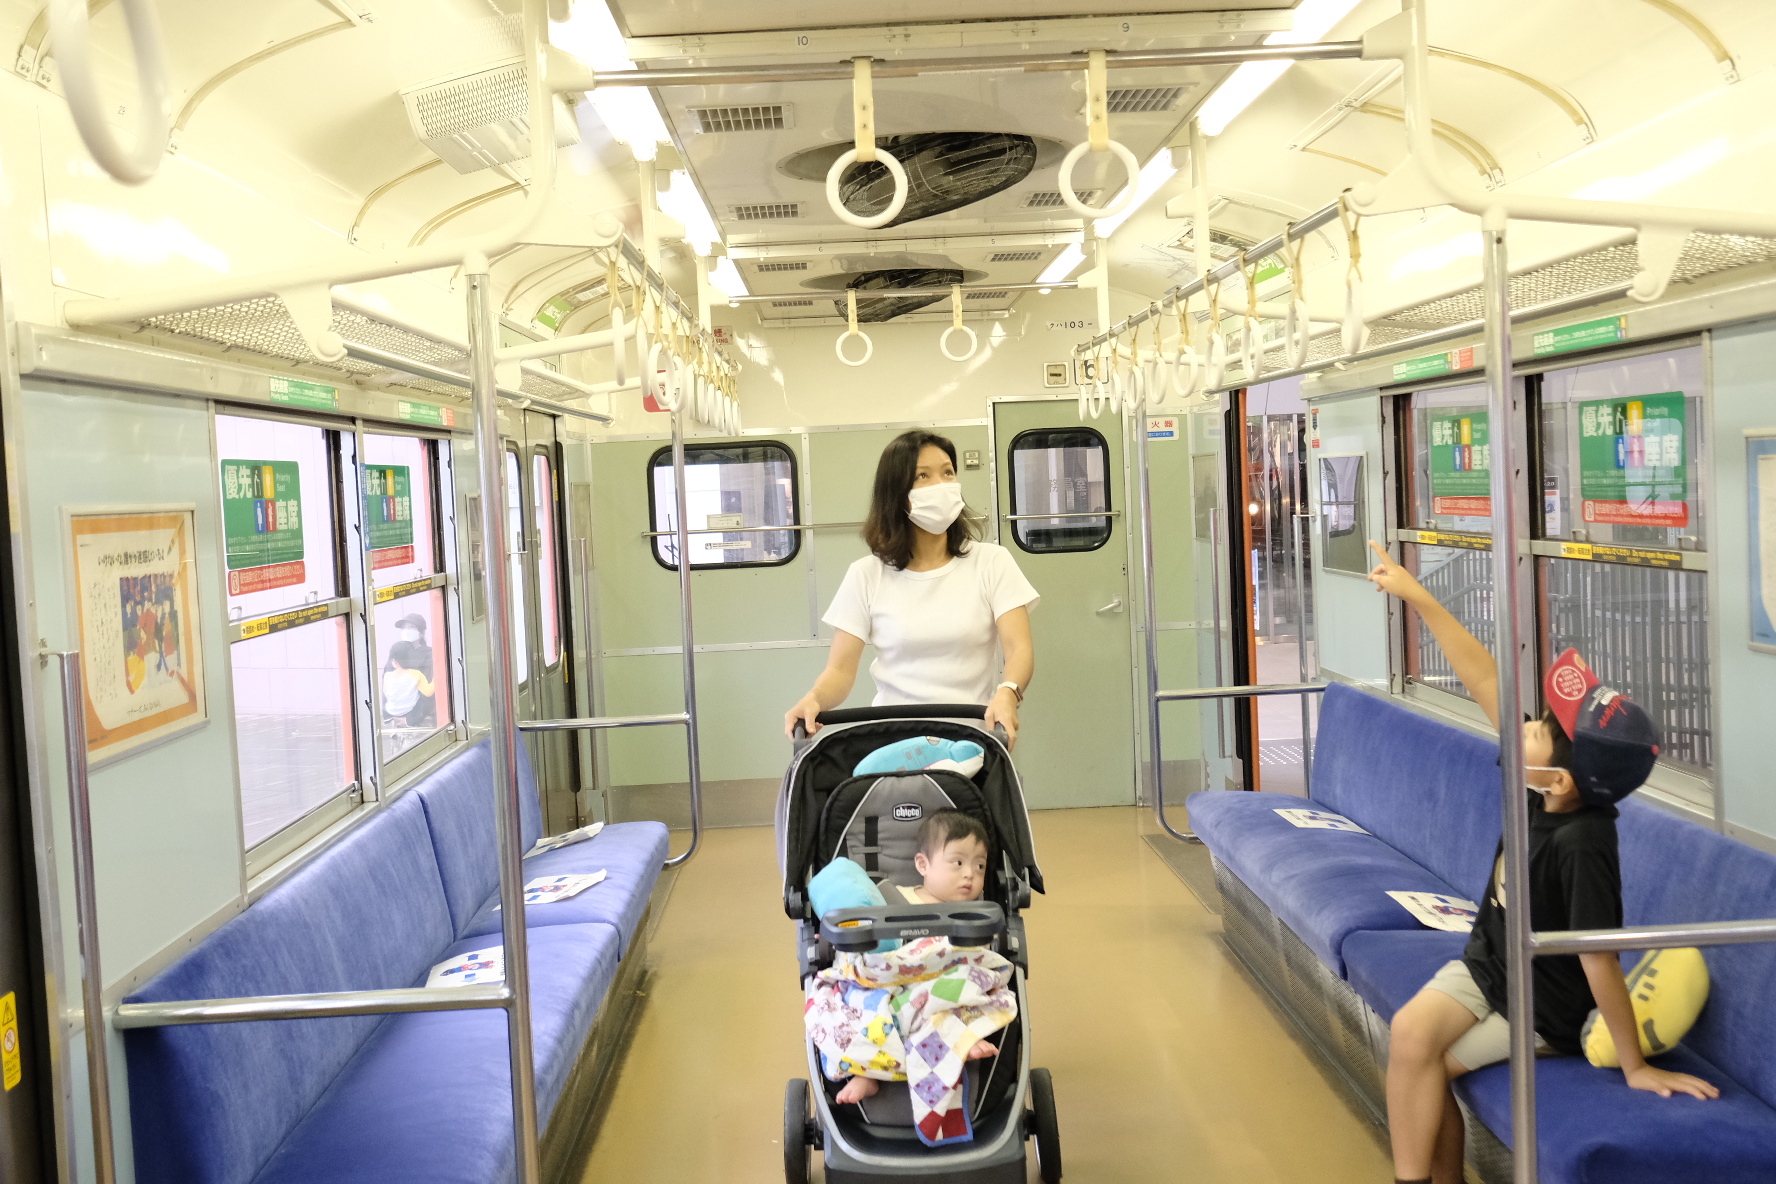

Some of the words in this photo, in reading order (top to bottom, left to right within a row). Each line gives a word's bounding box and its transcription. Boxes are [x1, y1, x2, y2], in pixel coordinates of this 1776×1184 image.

[1122, 22, 1130, 33] 9
[797, 36, 808, 46] 10
[1646, 406, 1669, 417] Priority
[1151, 420, 1173, 429] 火器
[1582, 404, 1613, 437] 優先
[1432, 420, 1453, 446] 優先
[1644, 434, 1680, 467] 座席
[225, 465, 252, 499] 優先
[276, 473, 291, 484] Priority
[277, 484, 286, 492] Seat
[395, 495, 410, 521] 座席
[275, 499, 299, 531] 座席
[896, 806, 920, 818] chicco
[900, 928, 930, 937] BRAVO
